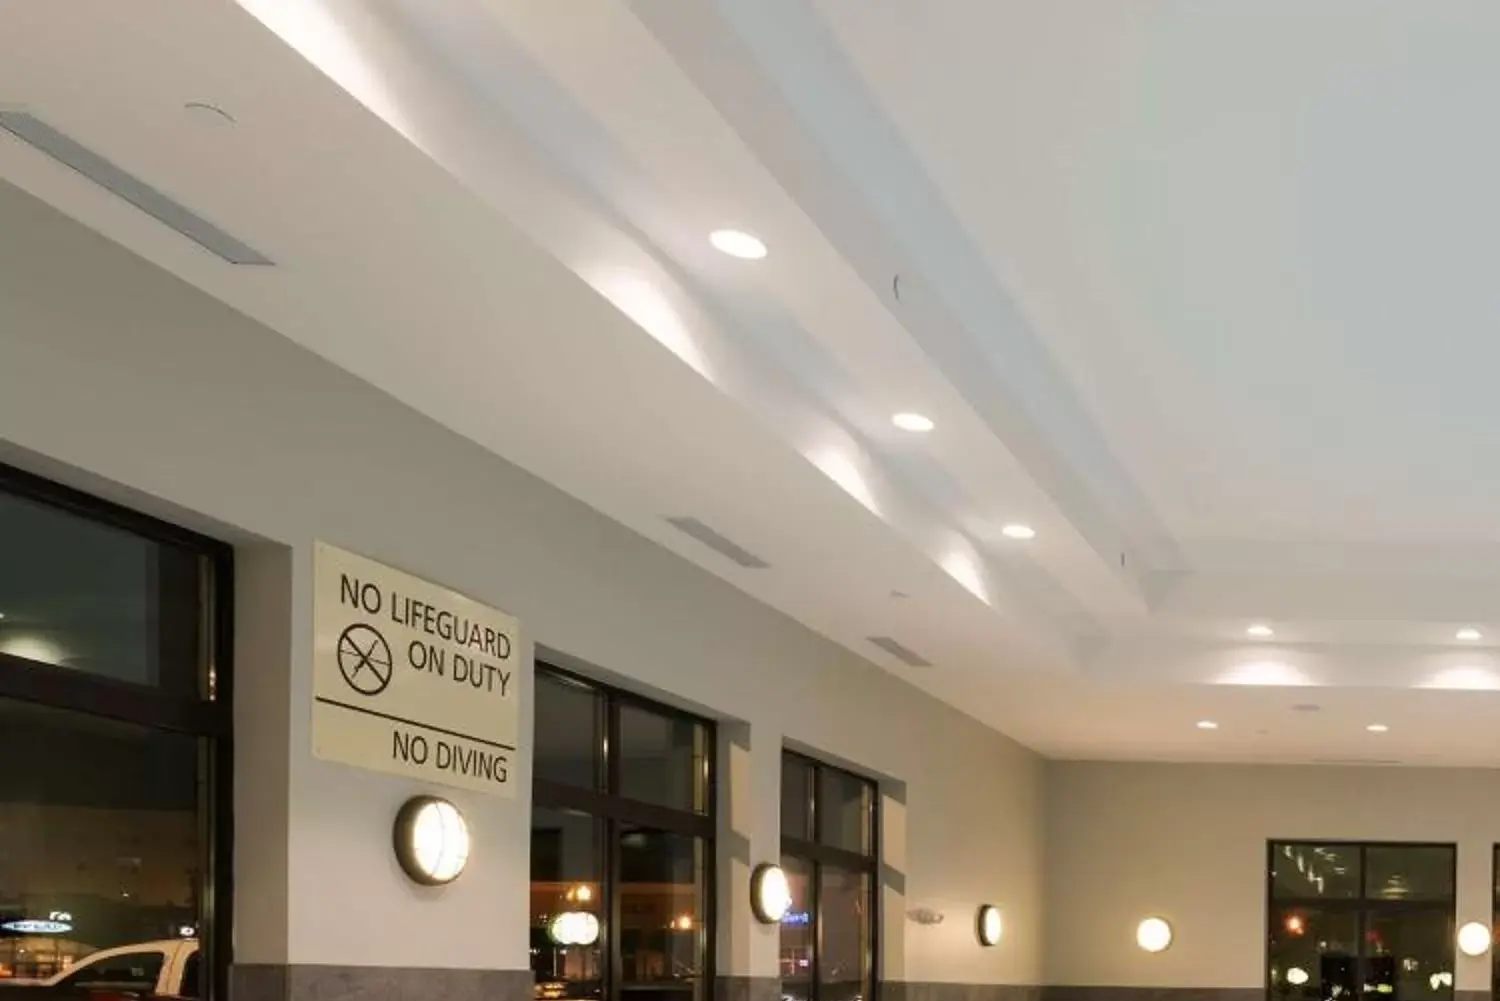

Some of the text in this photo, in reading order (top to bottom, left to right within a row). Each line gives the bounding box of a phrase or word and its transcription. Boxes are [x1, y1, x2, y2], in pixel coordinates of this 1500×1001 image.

[340, 573, 511, 660] NO LIFEGUARD
[408, 640, 511, 697] ON DUTY
[392, 730, 508, 783] NO DIVING
